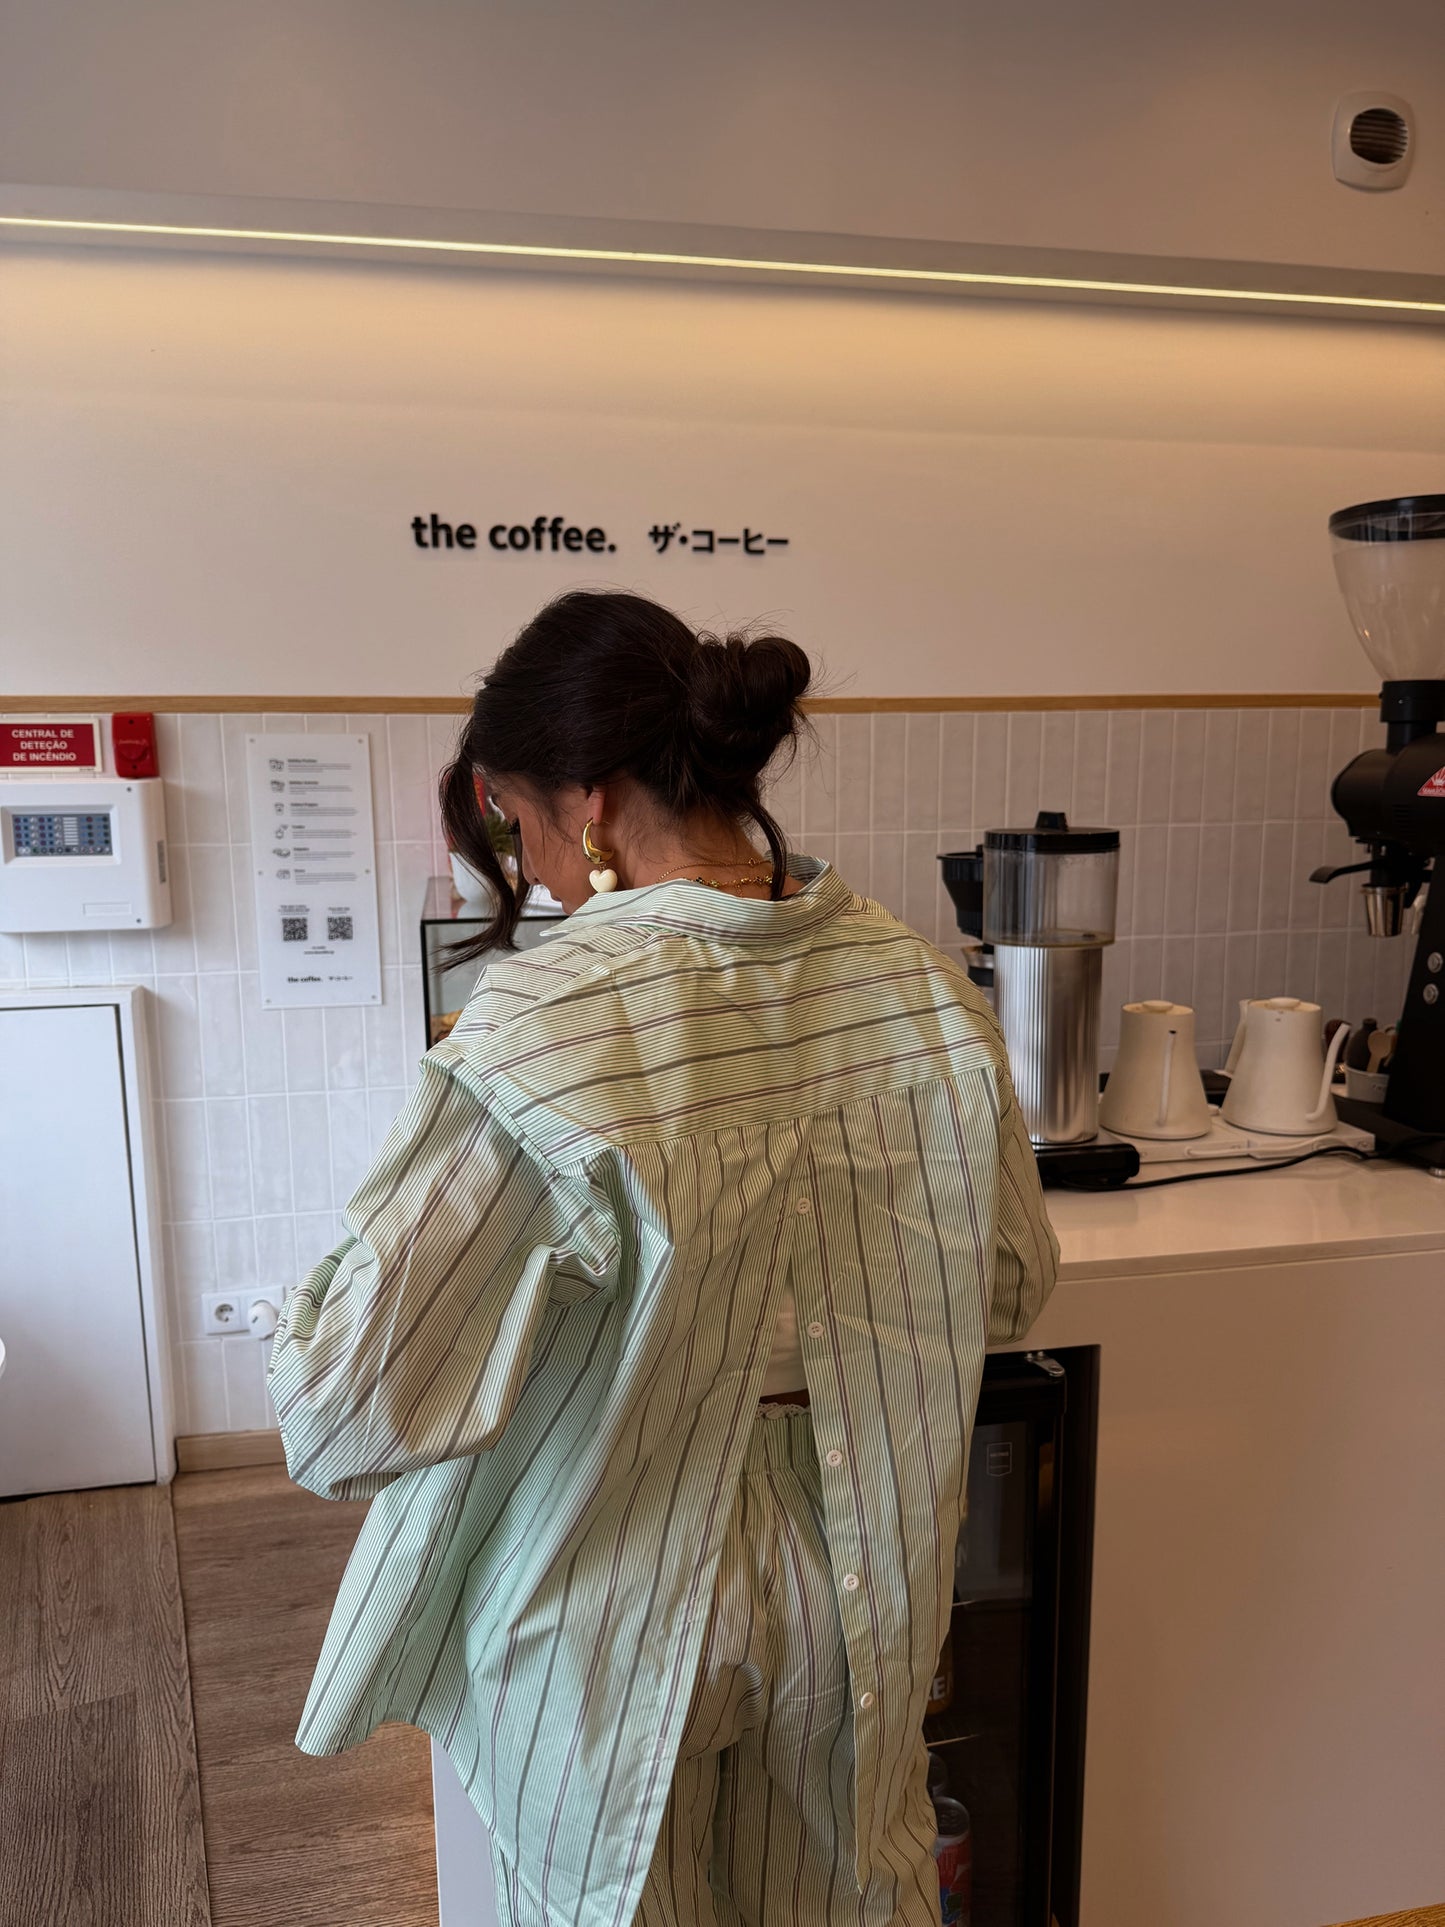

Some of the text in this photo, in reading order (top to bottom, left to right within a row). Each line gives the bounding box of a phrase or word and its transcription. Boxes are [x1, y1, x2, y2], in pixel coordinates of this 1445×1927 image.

[411, 514, 617, 553] the coffee.
[648, 522, 790, 555] ザ・コーヒー
[11, 729, 74, 738] CENTRAL DE
[20, 739, 68, 751] DETEÇÃO
[13, 751, 76, 762] DE INCÊNDIO
